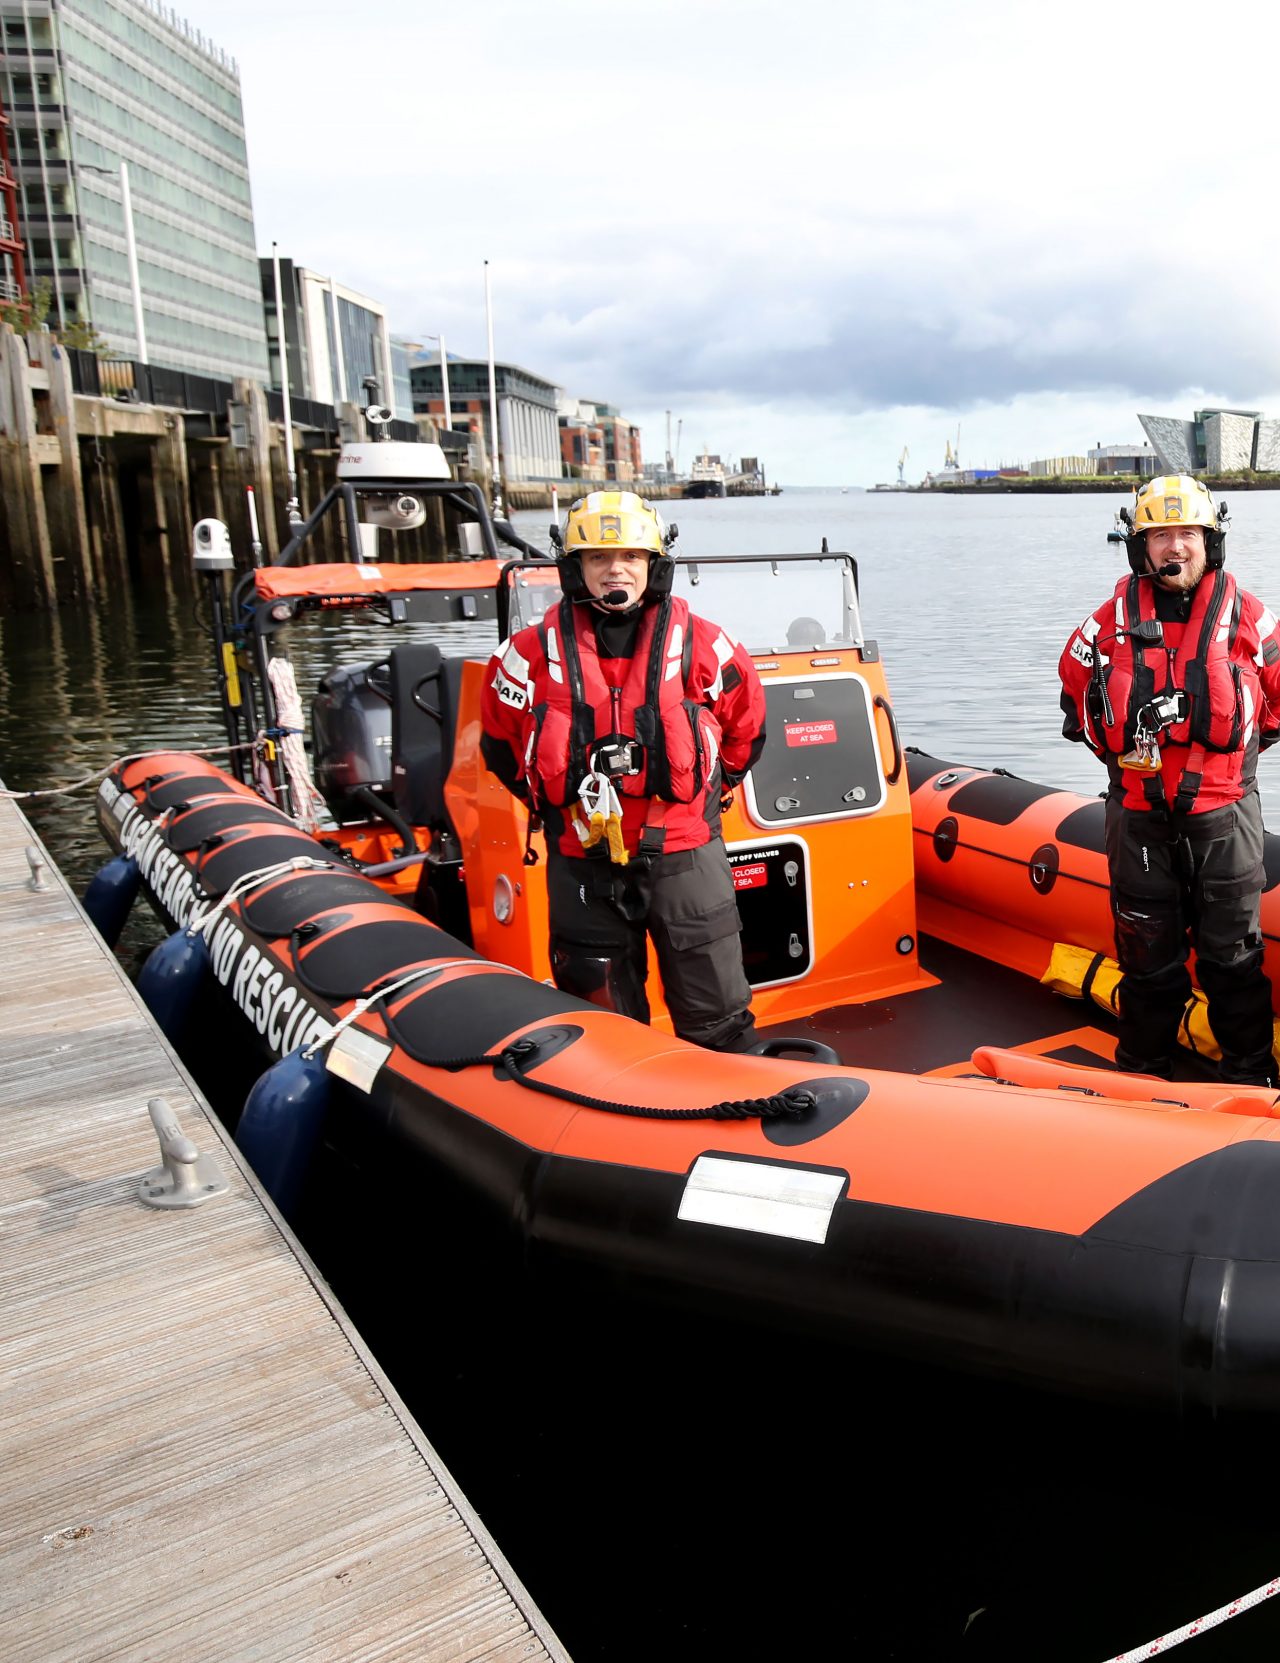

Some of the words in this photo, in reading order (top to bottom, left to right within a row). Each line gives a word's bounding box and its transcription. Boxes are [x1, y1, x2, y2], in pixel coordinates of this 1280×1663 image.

[786, 726, 805, 735] KEEP
[806, 724, 834, 733] CLOSED
[809, 734, 823, 742] SEA
[753, 850, 780, 859] VALVES
[734, 866, 766, 877] CLOSED
[738, 878, 753, 886] SEA
